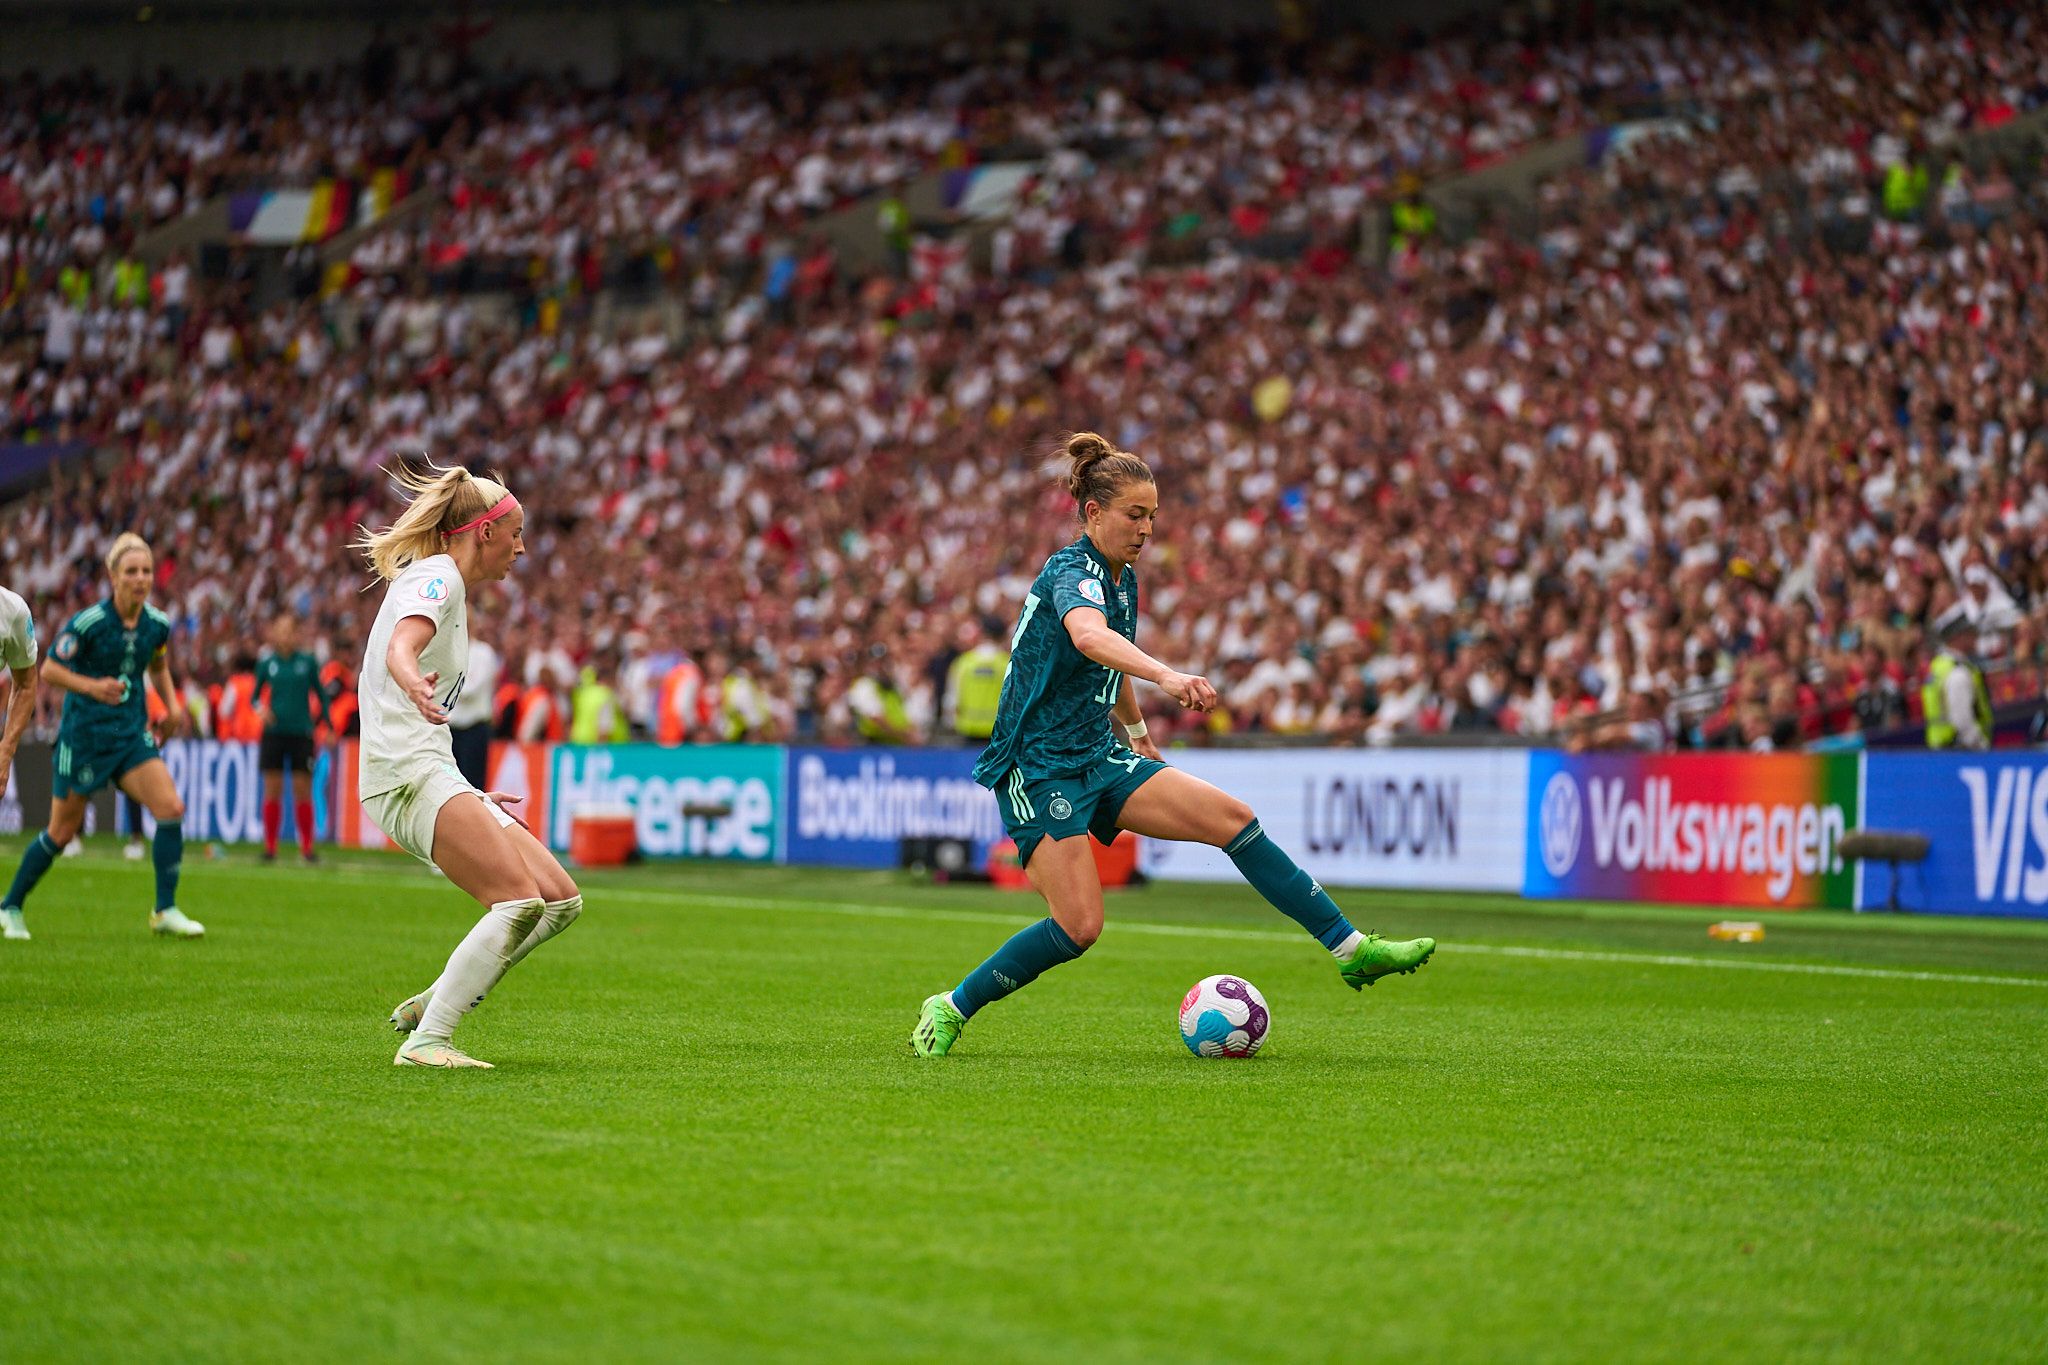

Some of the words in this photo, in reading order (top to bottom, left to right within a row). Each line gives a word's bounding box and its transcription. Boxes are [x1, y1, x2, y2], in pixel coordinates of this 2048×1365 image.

[142, 738, 265, 843] RIFOL
[1304, 775, 1460, 859] LONDON
[1588, 776, 1845, 900] Volkswagen
